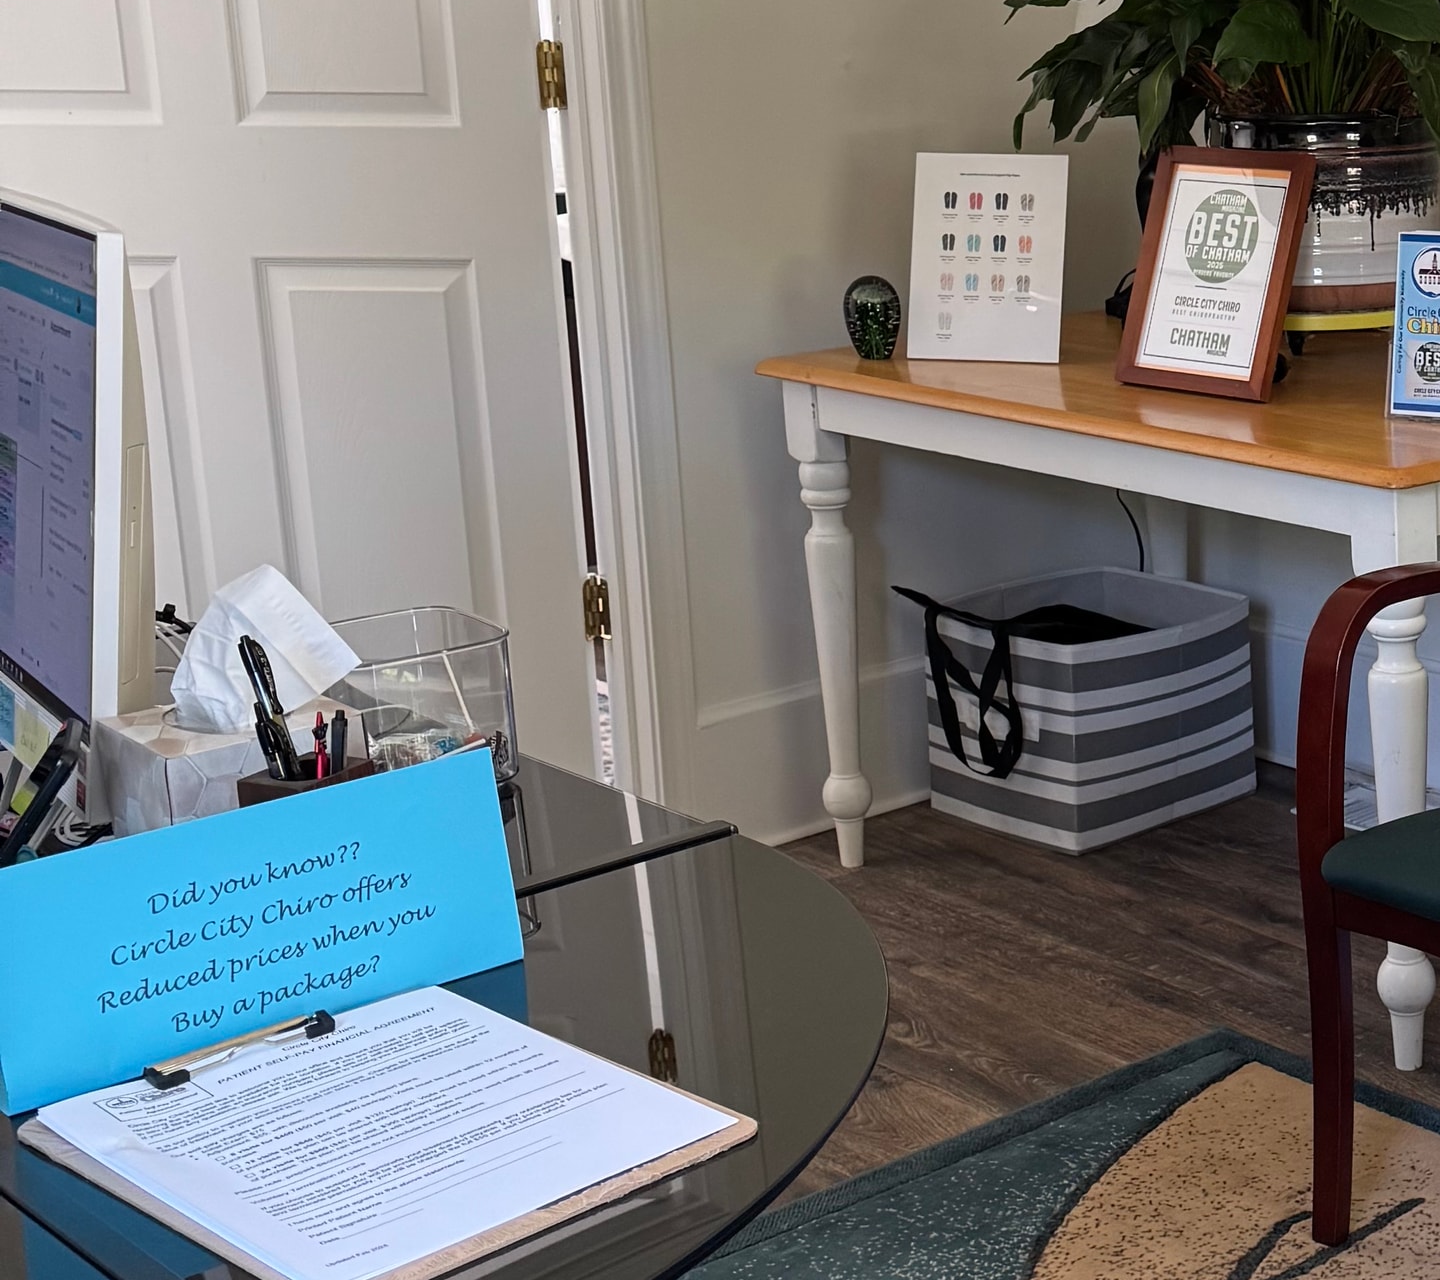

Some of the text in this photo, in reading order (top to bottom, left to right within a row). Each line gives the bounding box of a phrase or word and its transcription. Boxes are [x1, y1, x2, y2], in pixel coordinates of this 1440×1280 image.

[1210, 194, 1248, 208] CHATHAM
[1188, 211, 1258, 250] BEST
[1186, 245, 1251, 264] OF CHATHAM
[1172, 308, 1236, 322] BEST CHIROPRACTOR
[1175, 295, 1241, 313] CIRCLE CITY CHIRO
[1407, 306, 1437, 319] Circle
[1170, 327, 1231, 352] CHATHAM
[147, 841, 361, 915] Did you know??
[110, 872, 412, 966] Circle City Chiro offers
[96, 904, 437, 1014] Reduced prices when you
[171, 953, 381, 1033] Buy a package?
[217, 1007, 434, 1084] PATIENT SELF-PAY FINANCIAL AGREEMENT
